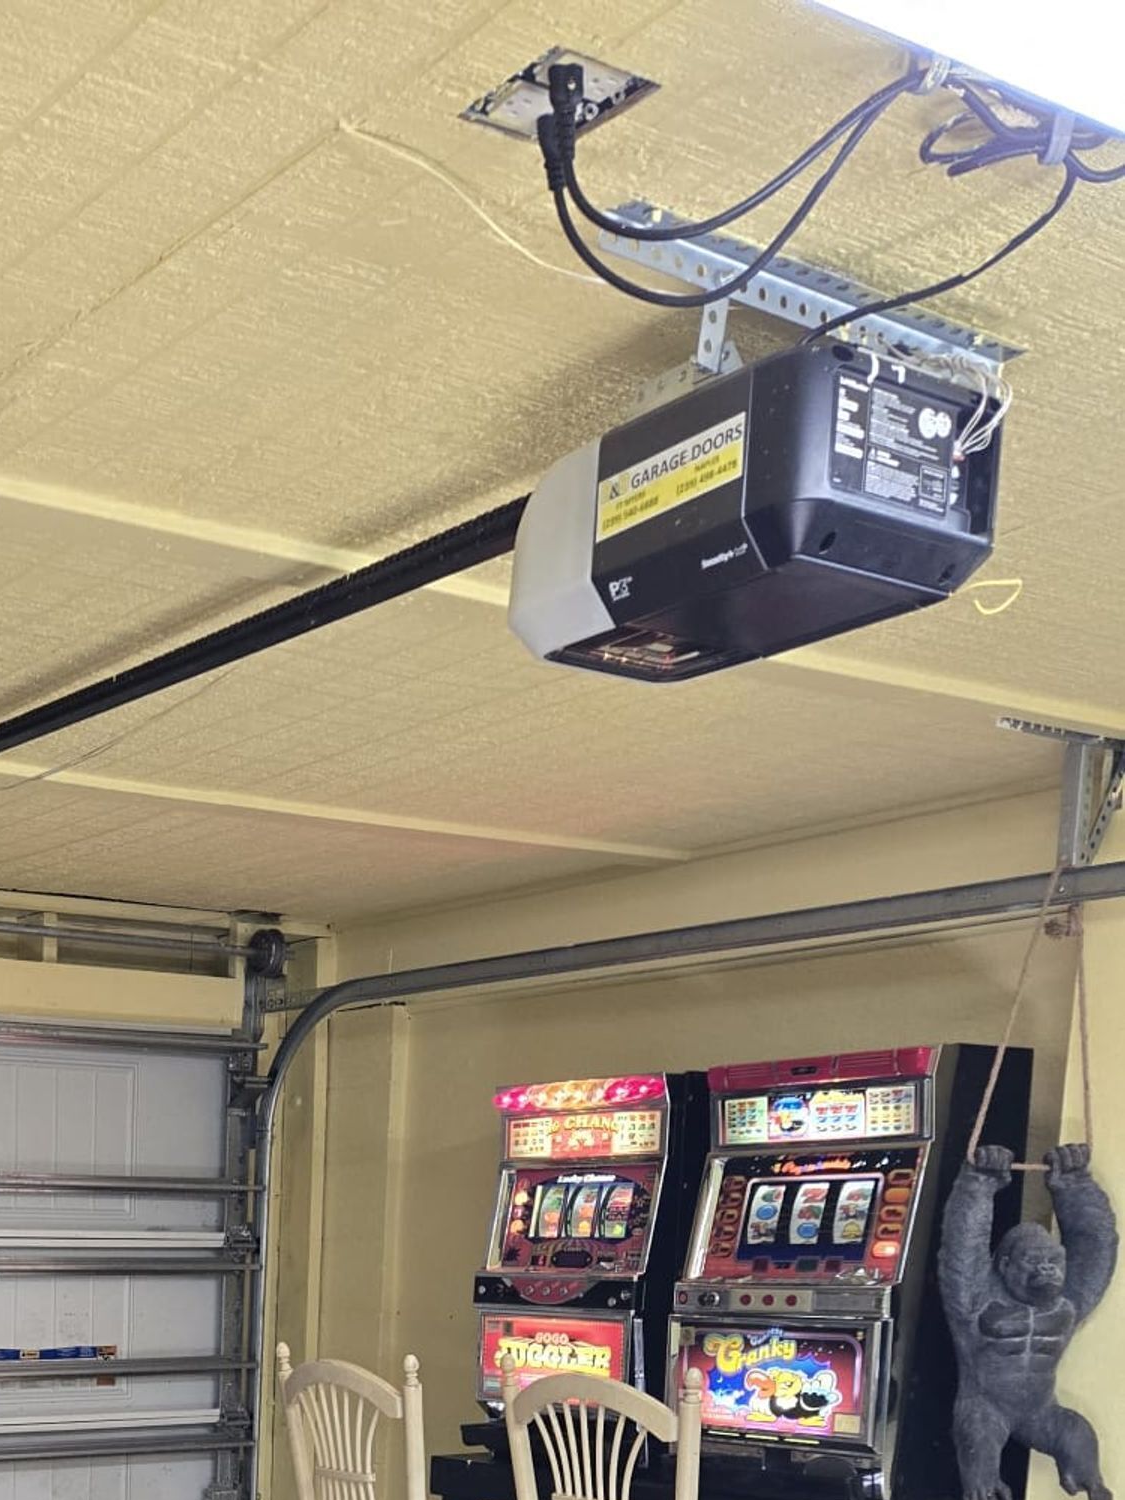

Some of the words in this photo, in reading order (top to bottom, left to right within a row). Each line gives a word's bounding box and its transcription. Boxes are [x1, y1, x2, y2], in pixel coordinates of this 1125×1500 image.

[631, 449, 688, 489] GARAGE
[691, 424, 743, 459] DOORS
[494, 1337, 612, 1375] JUGGLER
[535, 1331, 570, 1345] GOGO
